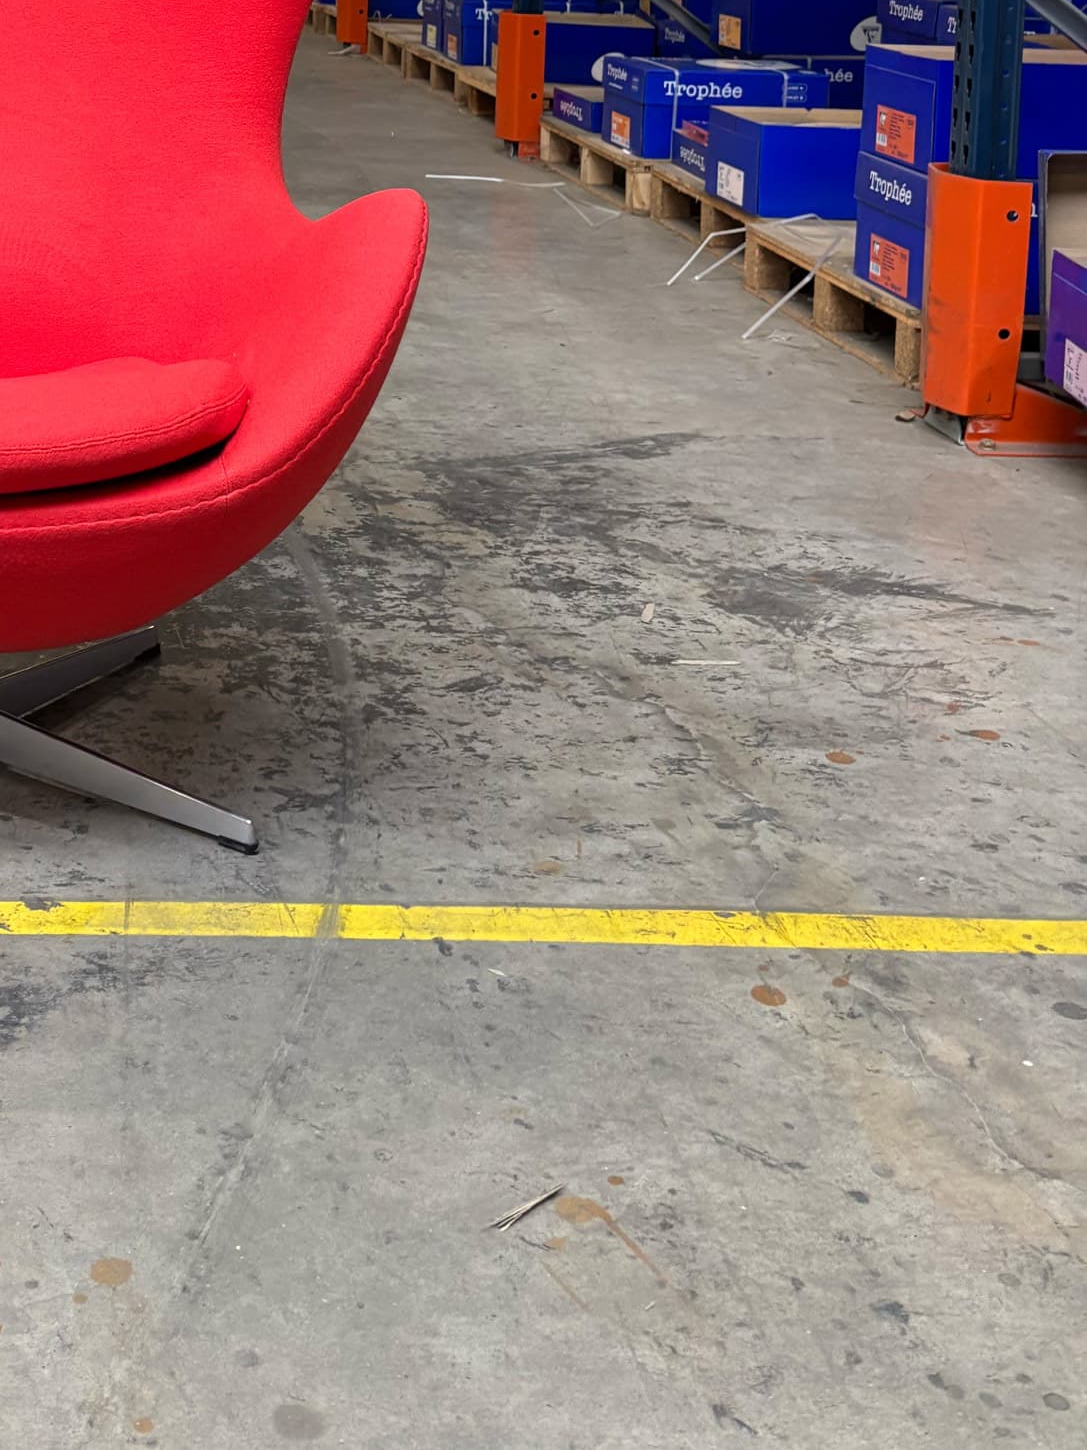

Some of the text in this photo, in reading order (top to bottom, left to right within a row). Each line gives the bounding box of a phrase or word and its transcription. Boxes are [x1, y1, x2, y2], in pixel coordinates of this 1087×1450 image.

[889, 0, 924, 22] Trophée
[664, 80, 743, 101] Trophée
[869, 170, 912, 206] Trophée
